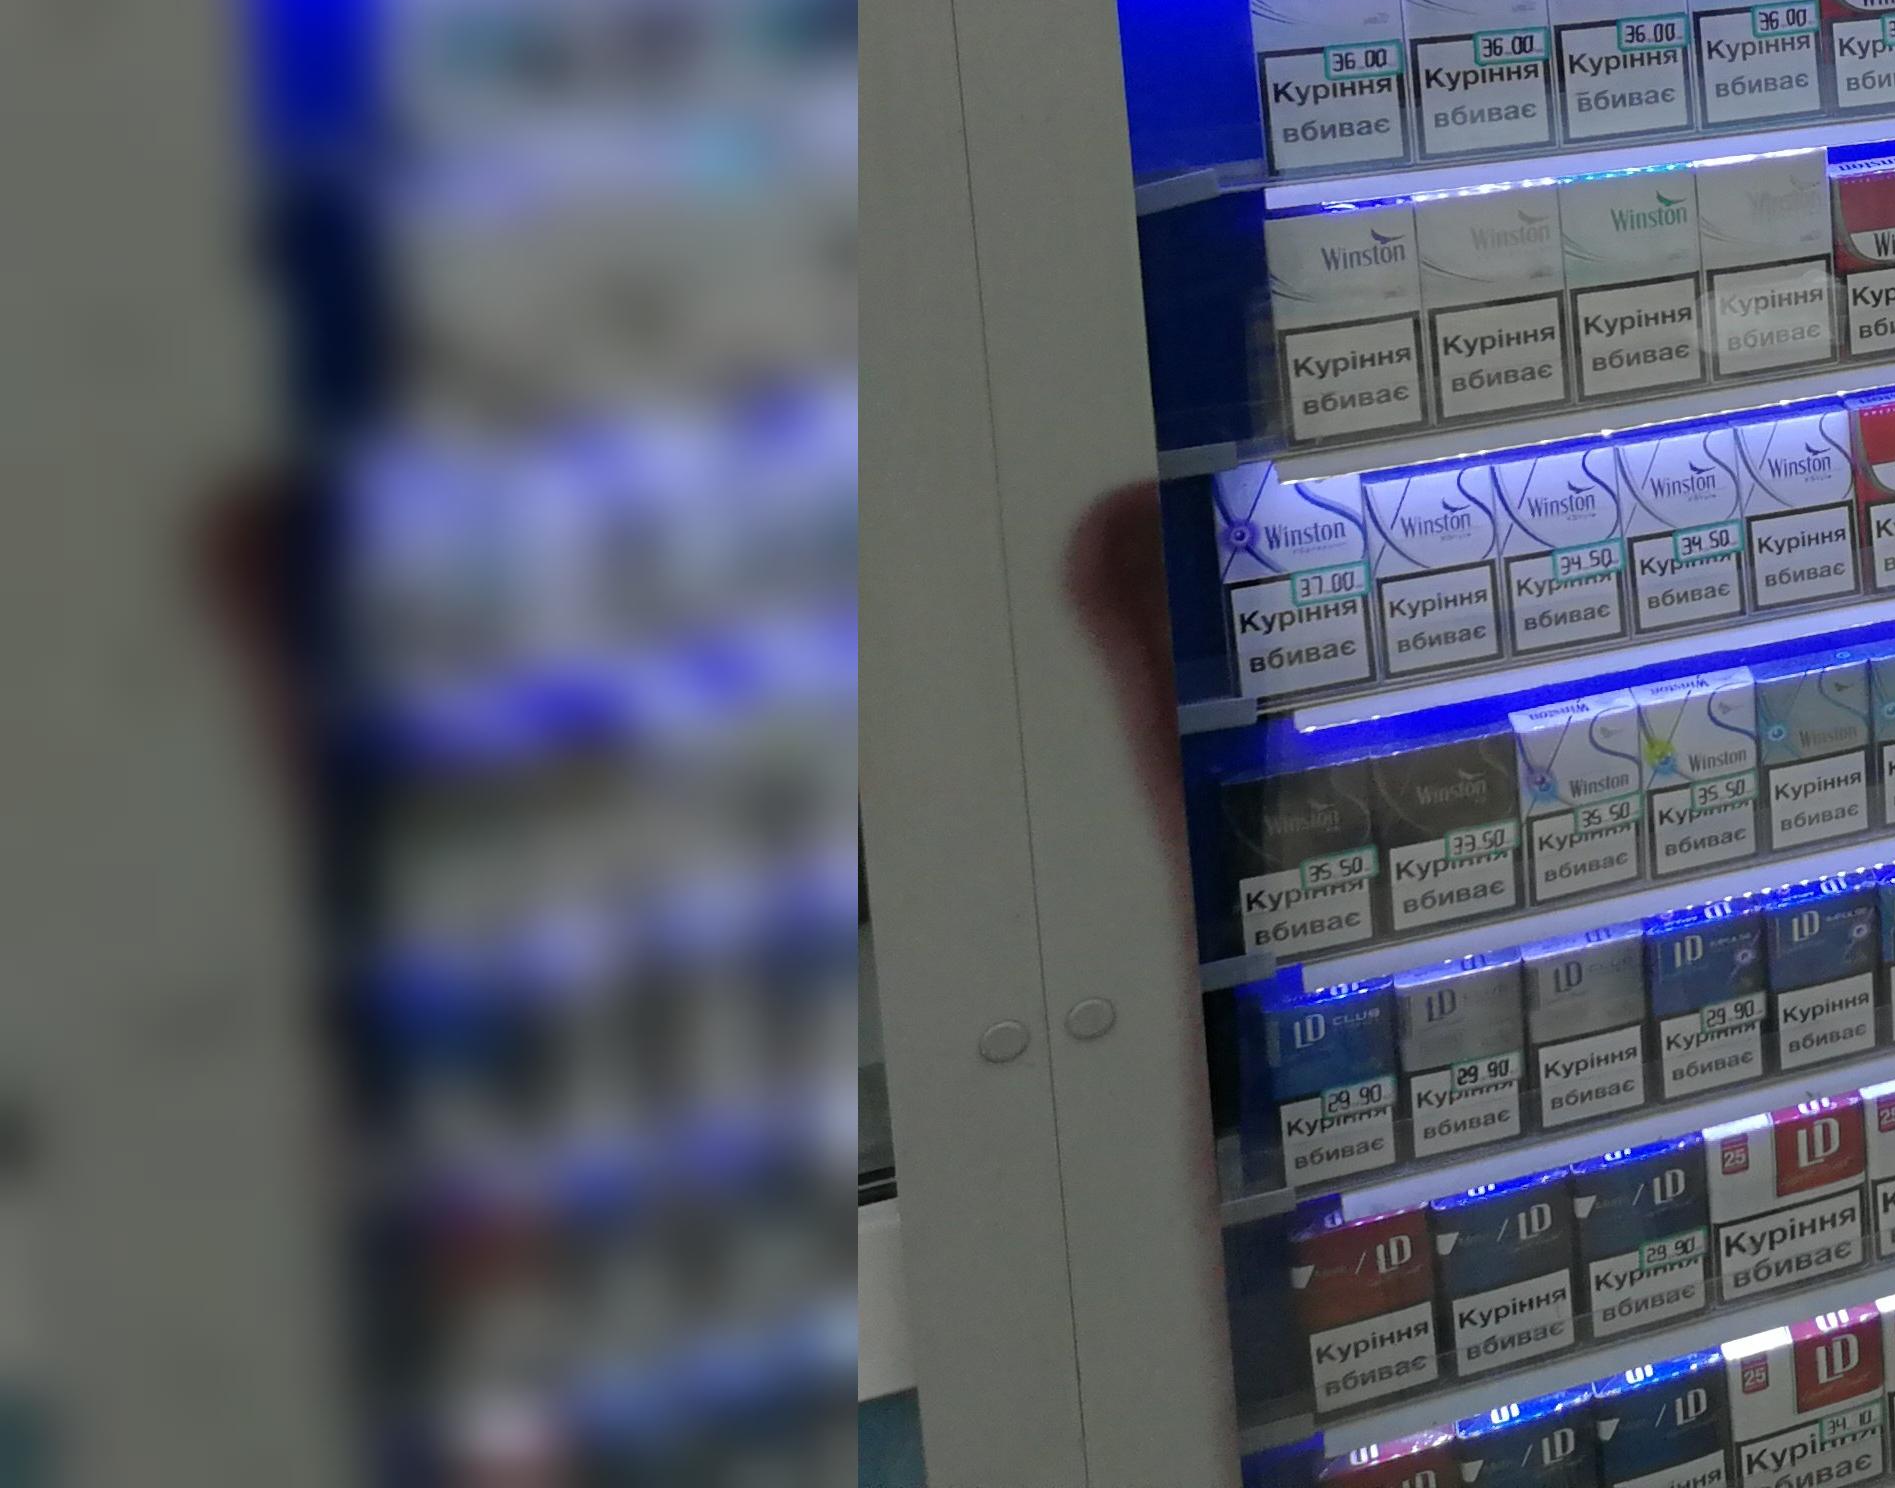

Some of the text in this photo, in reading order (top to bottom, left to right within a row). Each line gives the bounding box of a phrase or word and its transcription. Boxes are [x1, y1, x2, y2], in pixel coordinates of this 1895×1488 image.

[1714, 69, 1810, 99] вбиває
[1281, 114, 1391, 144] вбиває
[1433, 99, 1537, 129] вбиває
[1610, 202, 1688, 232] Winston
[1320, 239, 1406, 271] Winston
[1583, 305, 1693, 336] Куріння
[1293, 344, 1412, 378] Куріння
[1591, 341, 1690, 373] вбиває
[1303, 383, 1410, 415] вбиває
[1766, 451, 1832, 479] Winston
[1265, 518, 1347, 551] Winston
[1400, 508, 1472, 537] Winston
[1387, 588, 1489, 620] Куріння
[1396, 622, 1488, 655] вбиває
[1688, 746, 1748, 772] Winston
[1569, 770, 1630, 799] Winston
[1294, 1012, 1327, 1049] LD
[1543, 1044, 1639, 1081] Куріння
[1796, 1117, 1841, 1166] LD
